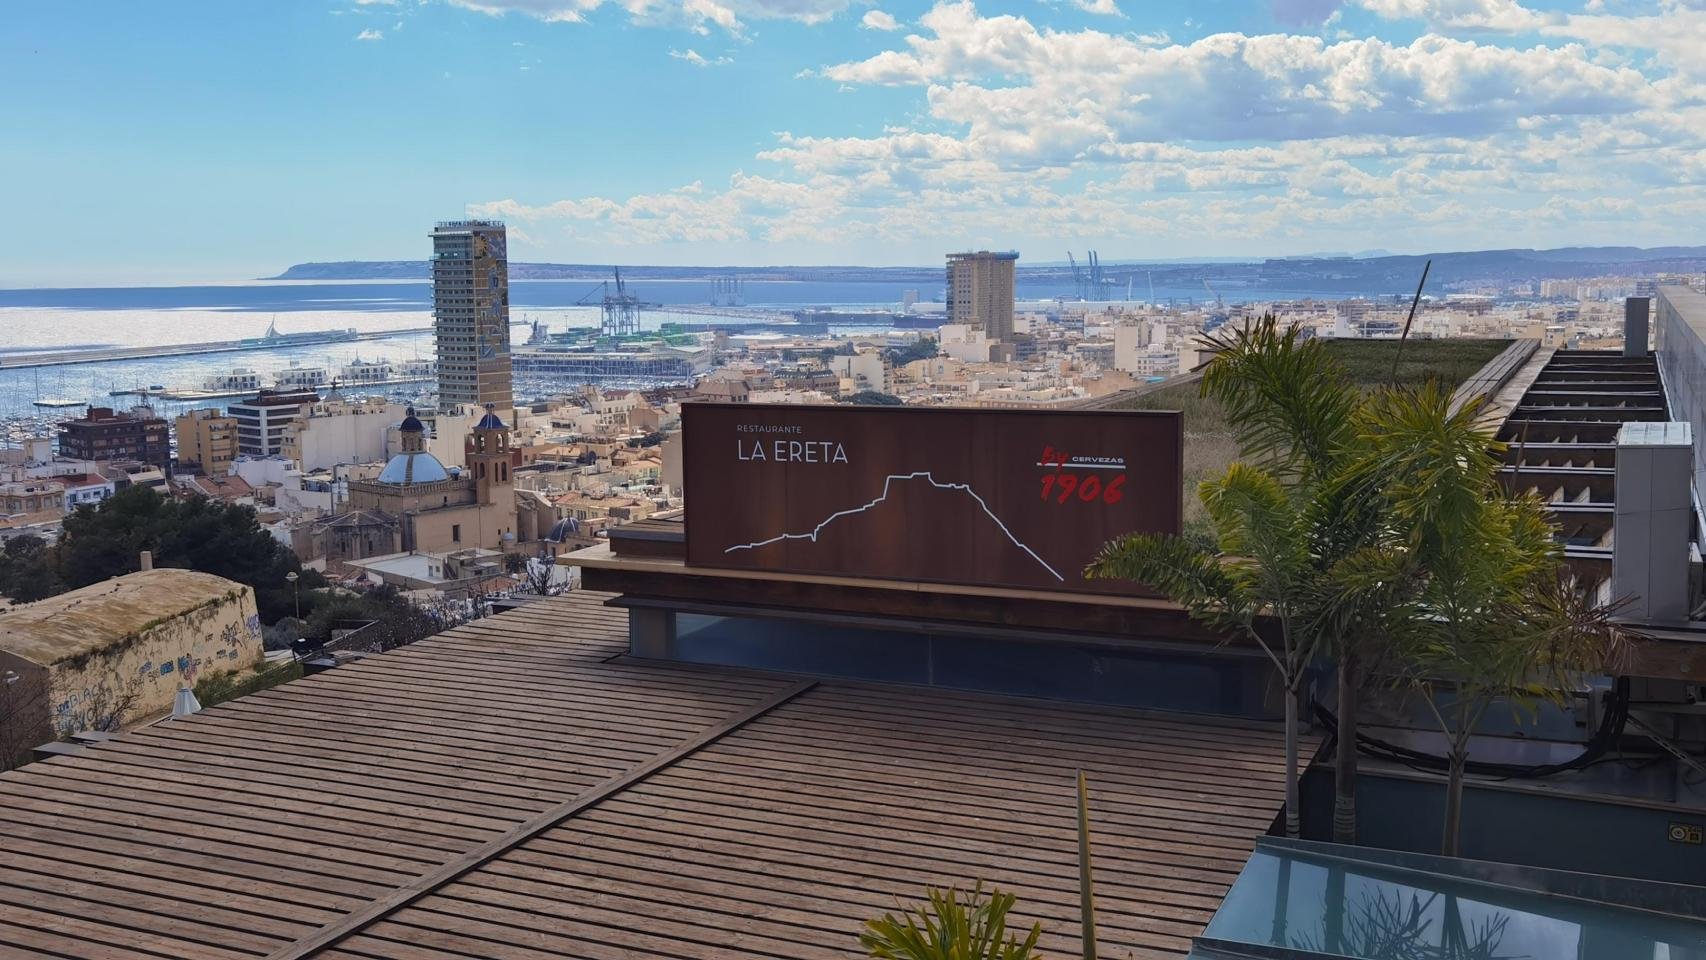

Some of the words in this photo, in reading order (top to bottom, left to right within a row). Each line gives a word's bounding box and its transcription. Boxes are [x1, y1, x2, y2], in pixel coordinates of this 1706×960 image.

[737, 425, 802, 433] RESTAURANTE
[738, 440, 766, 460] LA
[775, 441, 848, 463] ERETA
[1041, 475, 1126, 504] 1906
